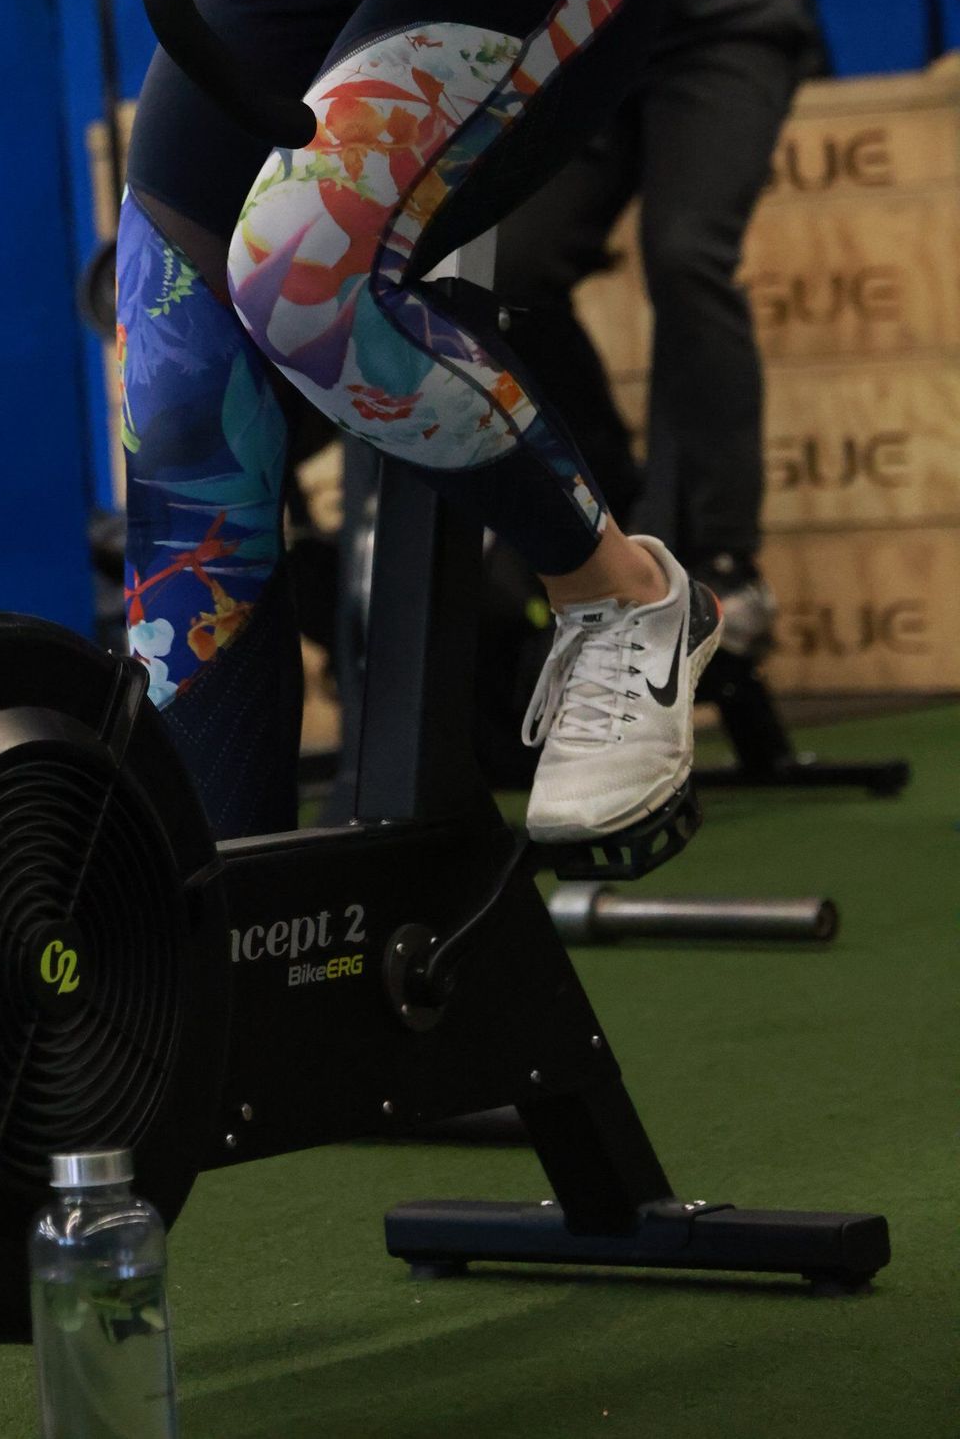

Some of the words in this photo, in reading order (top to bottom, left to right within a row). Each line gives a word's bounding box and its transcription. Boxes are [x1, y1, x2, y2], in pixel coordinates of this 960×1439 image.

[344, 904, 367, 943] 2
[41, 940, 80, 995] C2
[288, 954, 364, 987] BikeERG
